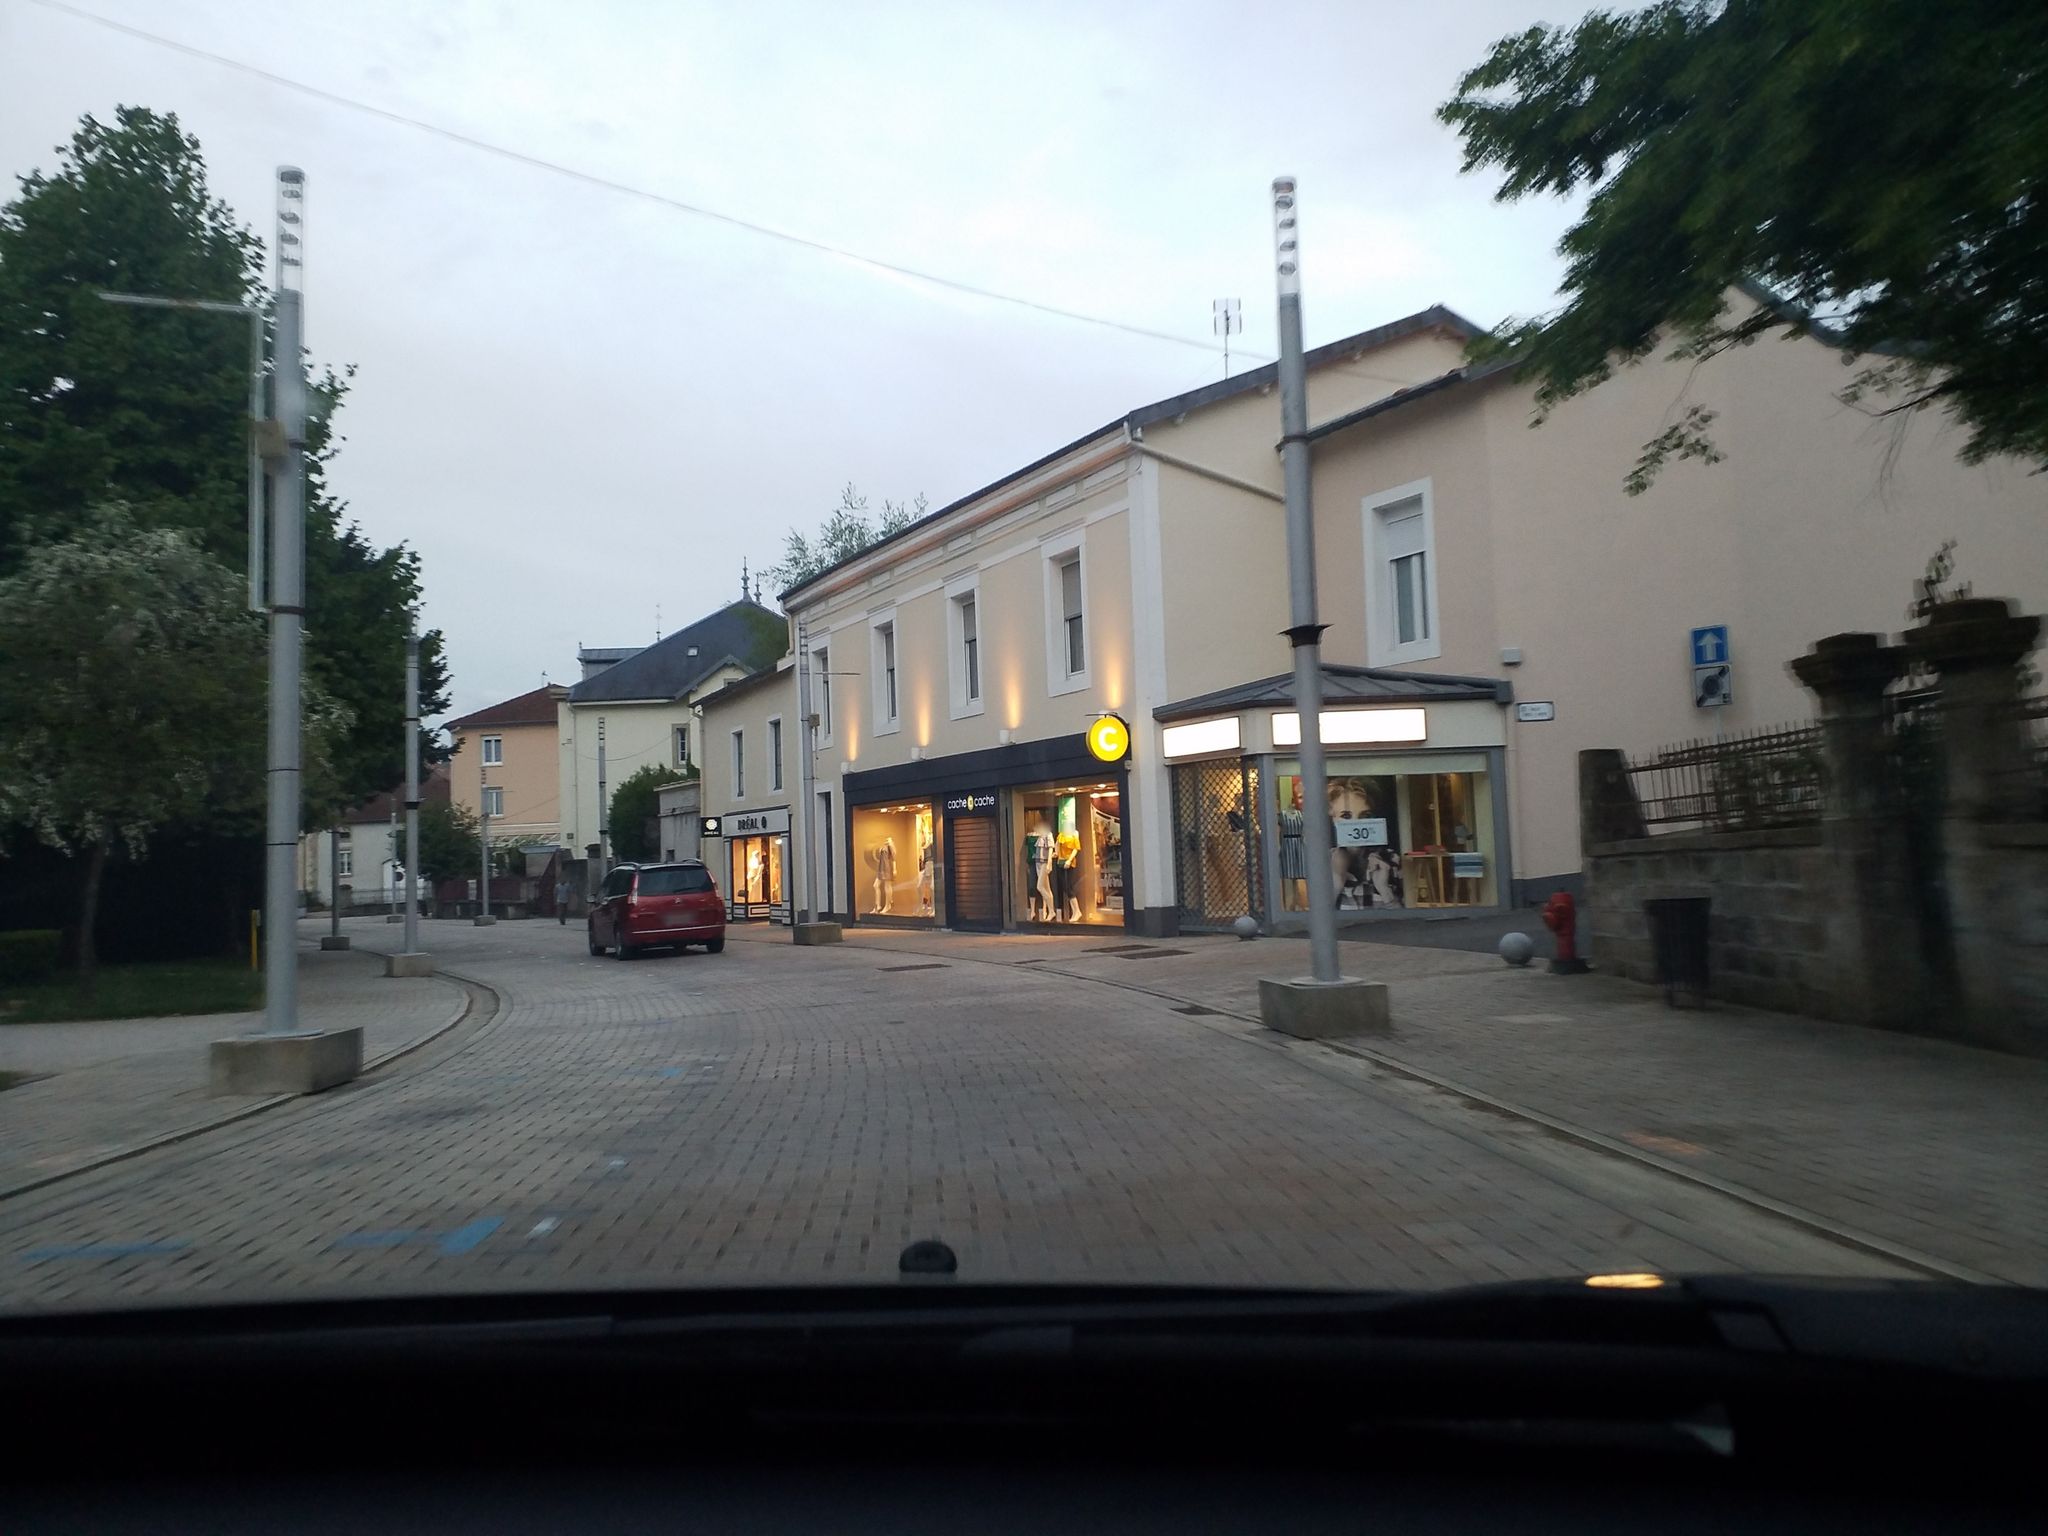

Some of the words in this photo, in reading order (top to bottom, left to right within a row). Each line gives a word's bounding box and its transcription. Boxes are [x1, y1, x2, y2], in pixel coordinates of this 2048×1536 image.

[1099, 727, 1118, 752] C
[947, 798, 967, 809] cache
[974, 795, 995, 807] cache
